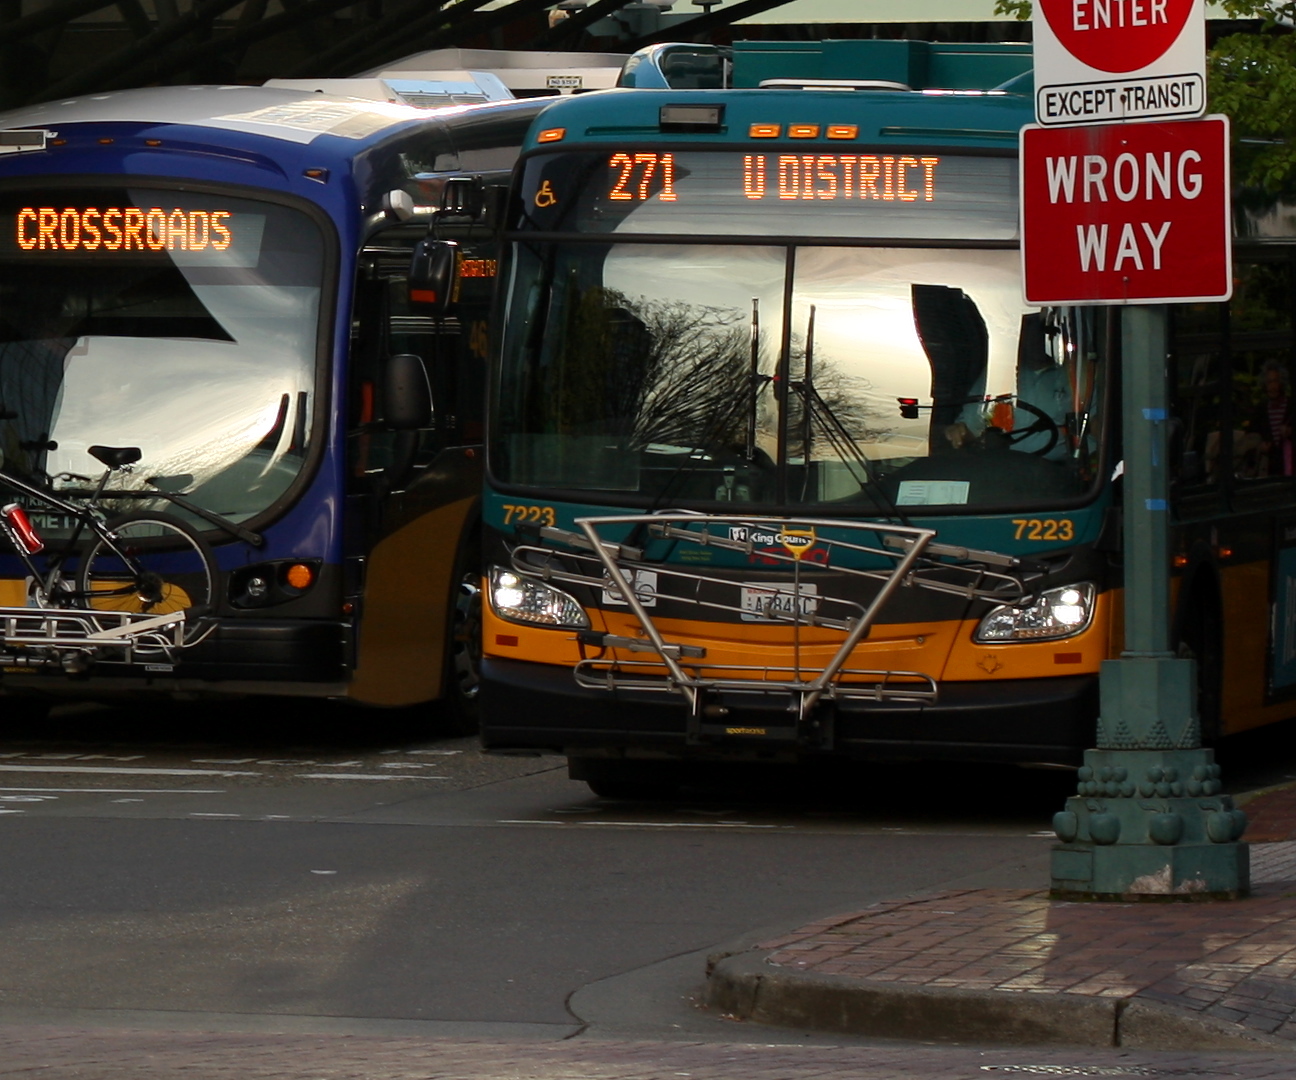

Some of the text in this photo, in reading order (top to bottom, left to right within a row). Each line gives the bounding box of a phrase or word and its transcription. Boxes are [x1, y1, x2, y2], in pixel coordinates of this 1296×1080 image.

[1046, 81, 1196, 118] EXCEPT TRANSIT
[609, 152, 940, 202] 271 U DISTRICT
[1046, 149, 1203, 204] WRONG
[17, 207, 233, 251] CROSSROADS
[1076, 221, 1172, 273] WAY
[503, 505, 556, 527] 7223
[1011, 519, 1074, 541] 7223
[749, 532, 774, 545] King
[191, 757, 437, 769] STOP
